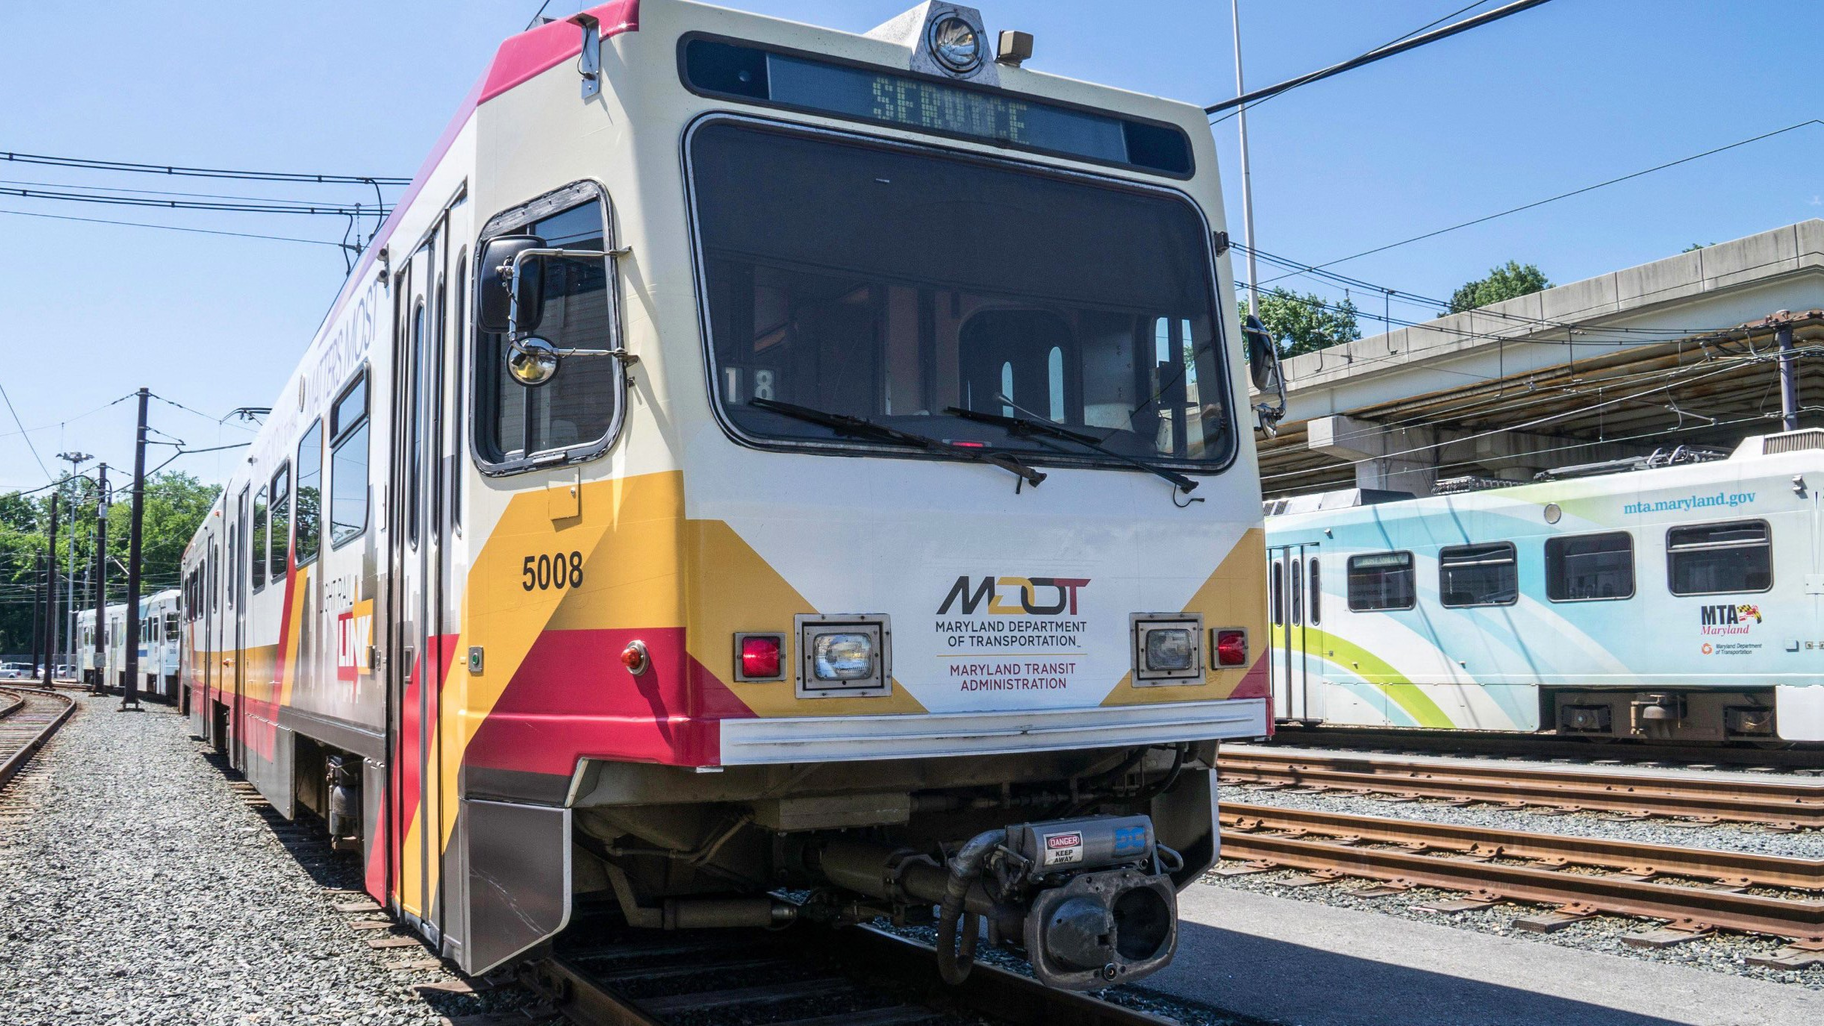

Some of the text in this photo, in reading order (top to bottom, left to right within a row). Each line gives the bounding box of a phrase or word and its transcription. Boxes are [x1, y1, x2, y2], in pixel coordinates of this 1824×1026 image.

[343, 279, 378, 377] MOST
[1623, 491, 1757, 514] mta.maryland.gov
[522, 550, 583, 592] 5008
[936, 575, 1092, 616] MDOT
[1701, 604, 1739, 626] MTA
[935, 621, 1087, 633] MARYLAND DEPARTMENT
[1700, 624, 1750, 637] Maryland
[338, 613, 373, 668] LINK
[947, 635, 1076, 647] OF TRANSPORTATION
[950, 662, 1076, 677] MARYLAND TRANSIT
[960, 677, 1067, 692] ADMINISTRATION
[1050, 837, 1079, 847] DANGER
[1055, 849, 1073, 857] KEEP
